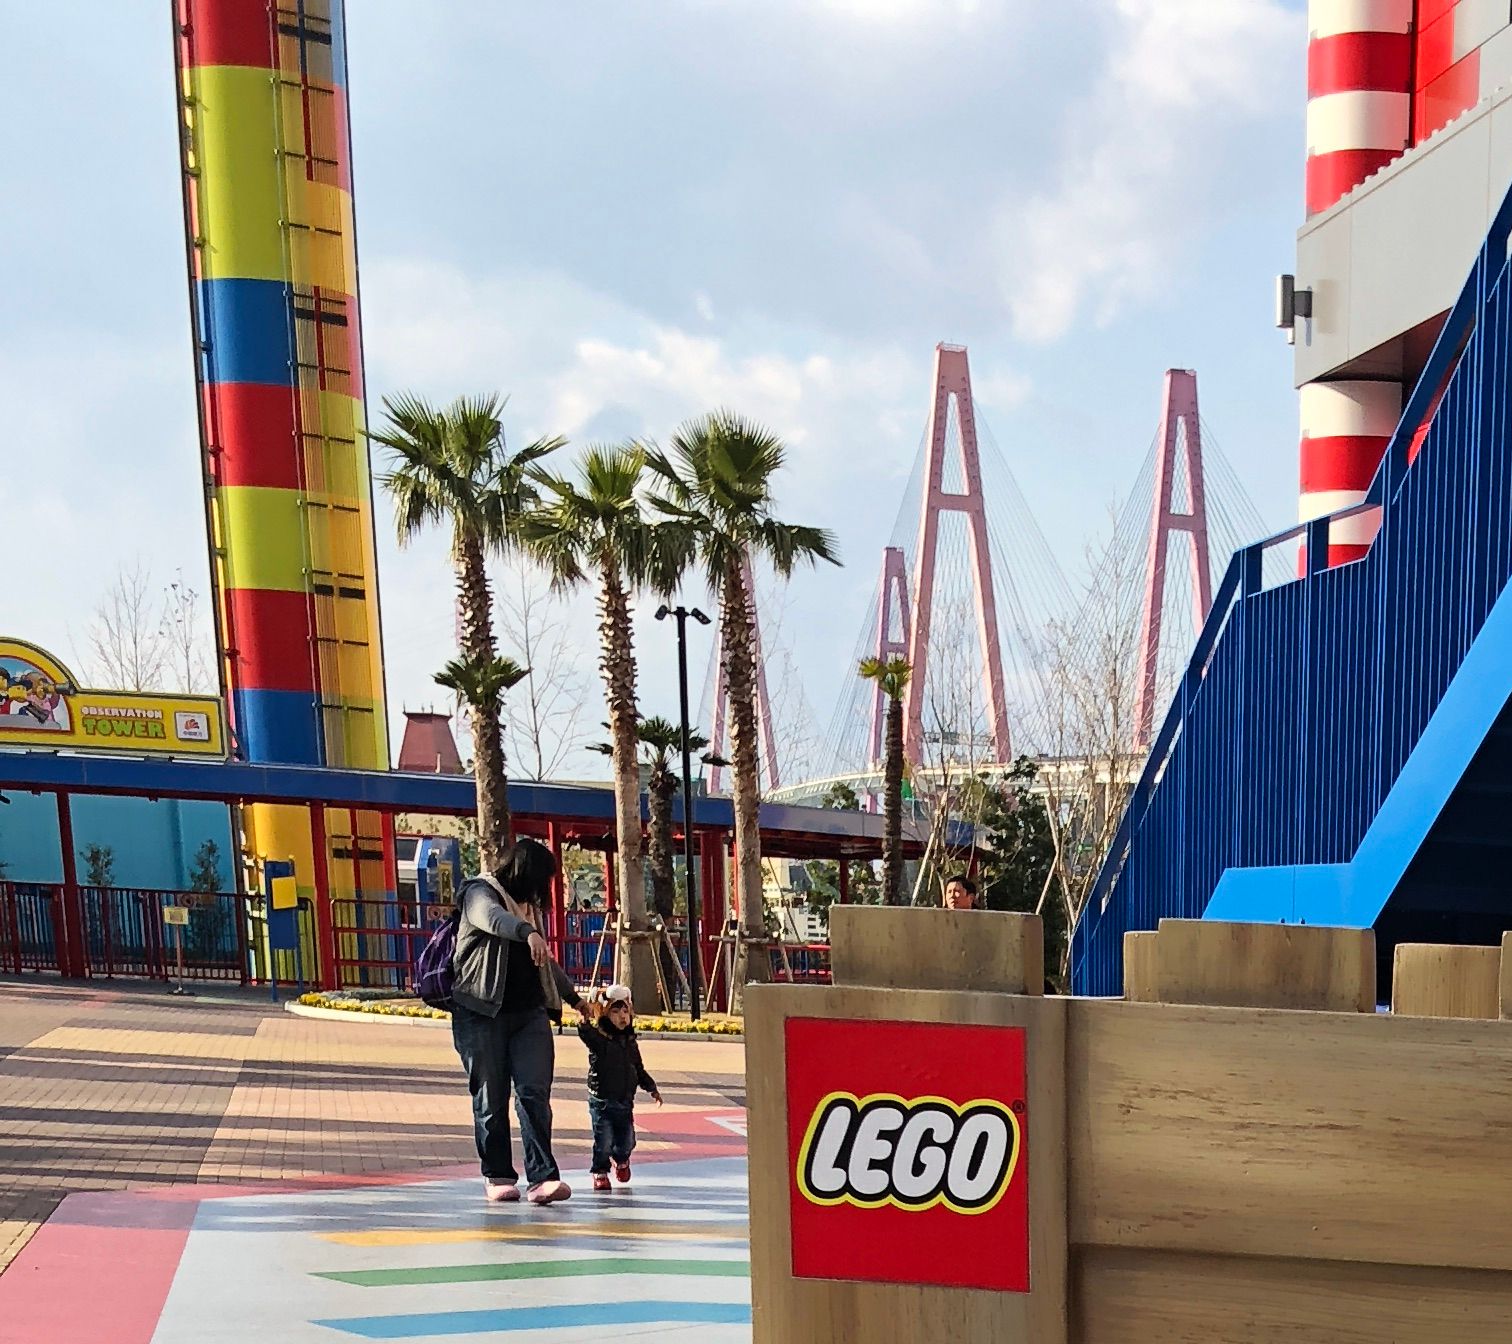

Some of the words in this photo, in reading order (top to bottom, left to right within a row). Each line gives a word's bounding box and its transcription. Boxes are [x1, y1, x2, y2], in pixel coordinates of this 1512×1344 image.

[81, 706, 163, 719] OBSERVATION
[83, 718, 166, 738] TOWER
[804, 1099, 1014, 1208] LEGO
